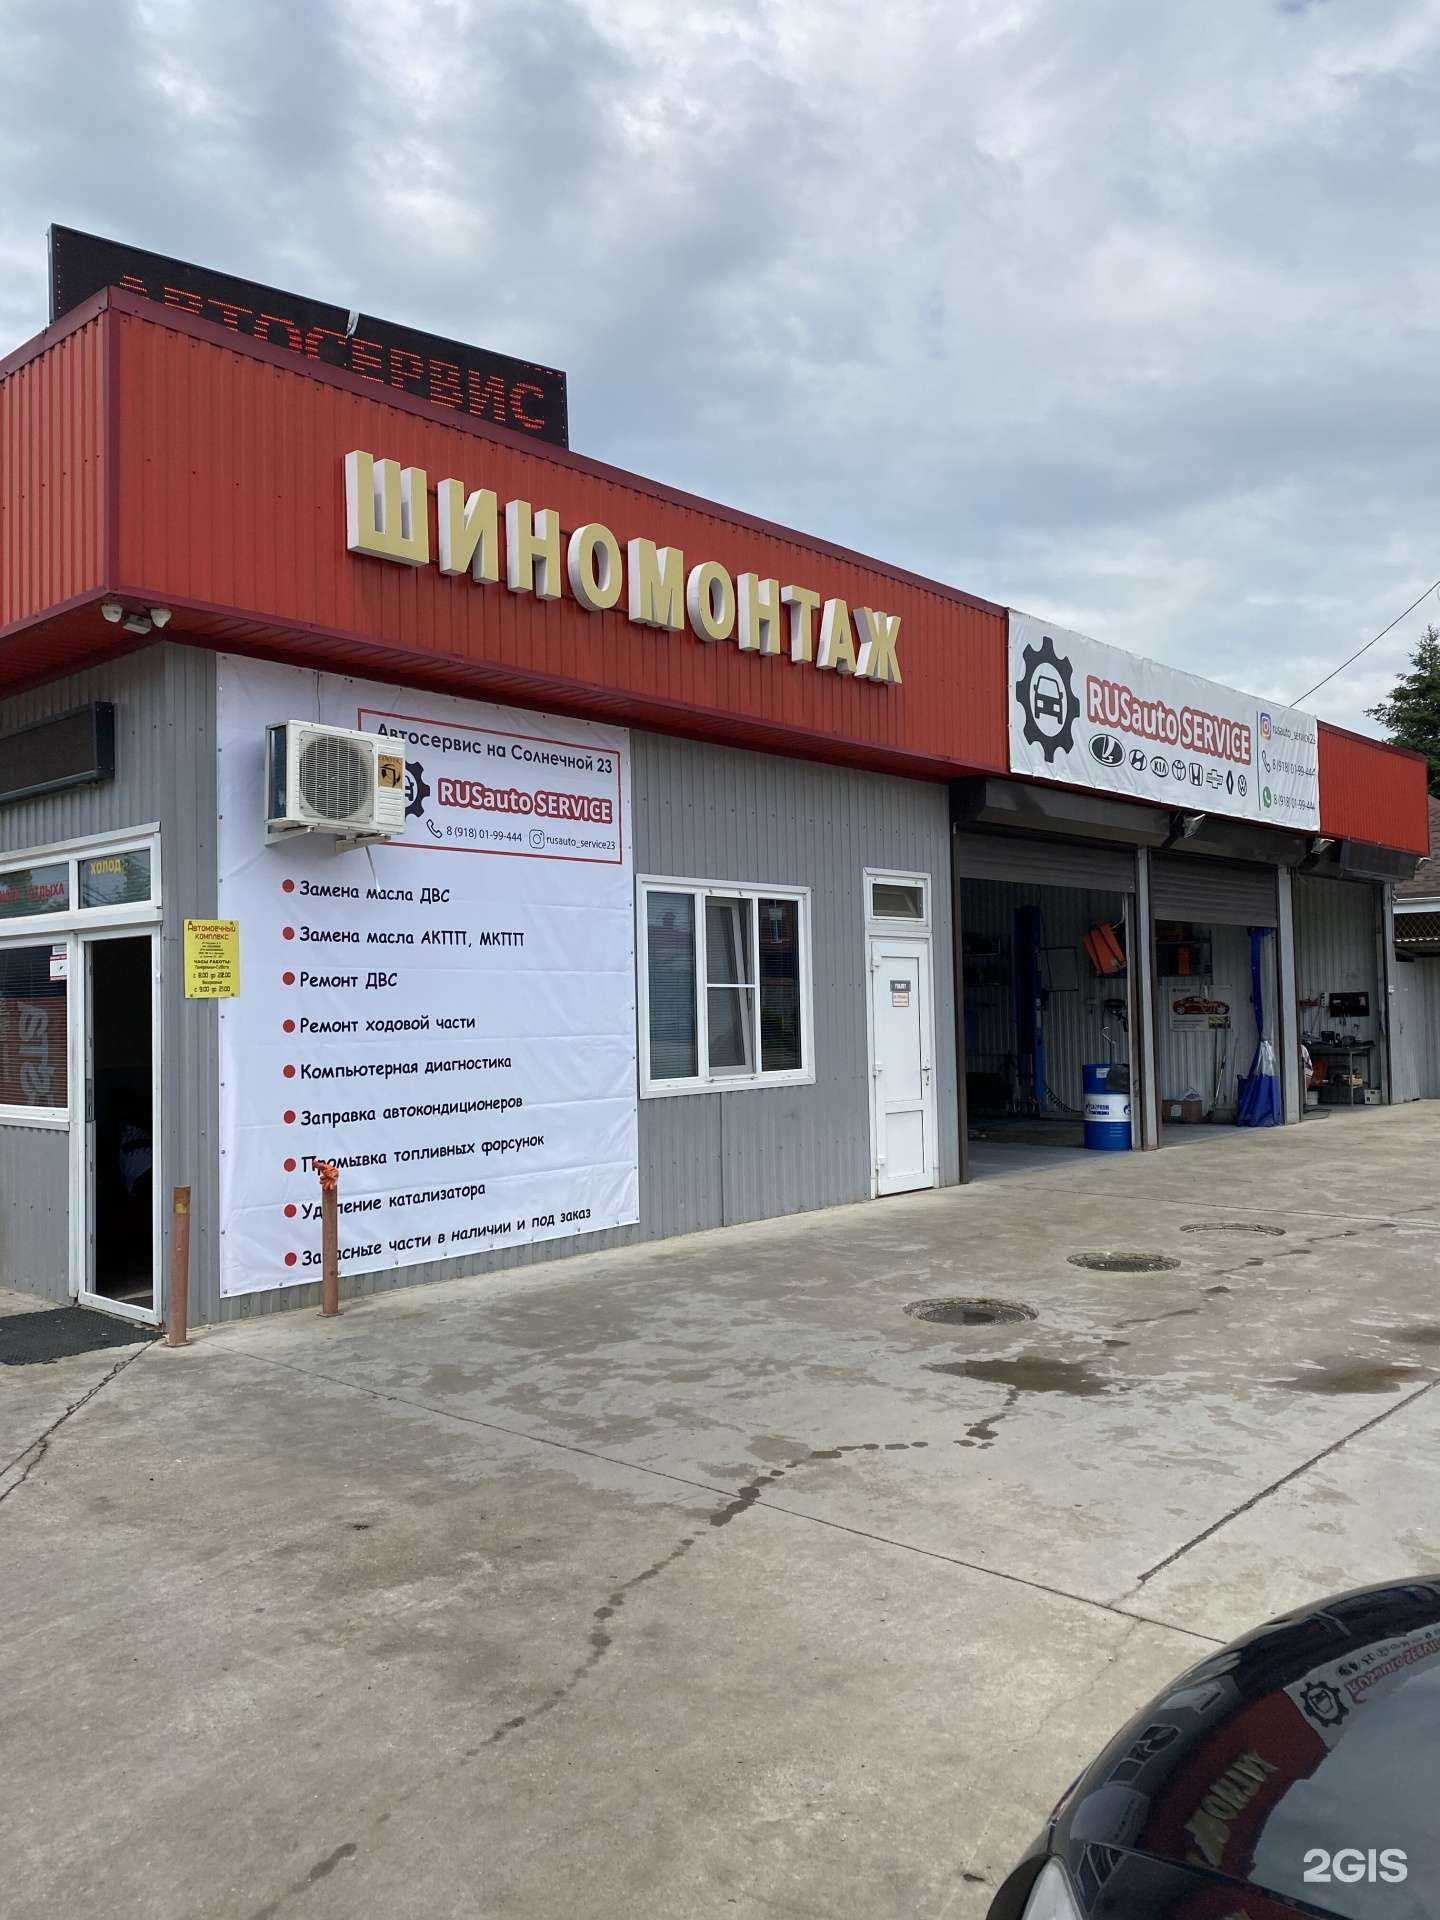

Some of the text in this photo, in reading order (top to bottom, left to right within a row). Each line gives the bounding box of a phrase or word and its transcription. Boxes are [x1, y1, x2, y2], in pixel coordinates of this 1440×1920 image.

[345, 450, 902, 684] ШИНОМОНТАЖ
[1089, 677, 1250, 763] RUSauto SERVICE
[377, 722, 613, 774] Автосервис на Солнечной 23
[1153, 760, 1167, 773] KIA
[439, 779, 612, 823] RUSauto SERVICE
[446, 825, 523, 843] 8 (918) 01-99-444
[546, 836, 616, 851] rusauto_service23
[299, 879, 450, 904] Замена масла ДВС
[299, 926, 524, 949] Замена масла АКПП, МКПП
[300, 972, 398, 990] Ремонт ДВС
[300, 1014, 476, 1034] Ремонт ходовой части
[300, 1056, 512, 1080] Компьютерная диагностика
[300, 1096, 523, 1128] Заправка автокондиционеров
[301, 1134, 545, 1175] Промывка топливных форсунок
[301, 1183, 486, 1220] Удление катализатора
[389, 1234, 432, 1251] части
[437, 1232, 446, 1244] в
[451, 1222, 512, 1242] наличии
[517, 1219, 526, 1231] и
[532, 1214, 555, 1229] под
[560, 1207, 592, 1223] заказ
